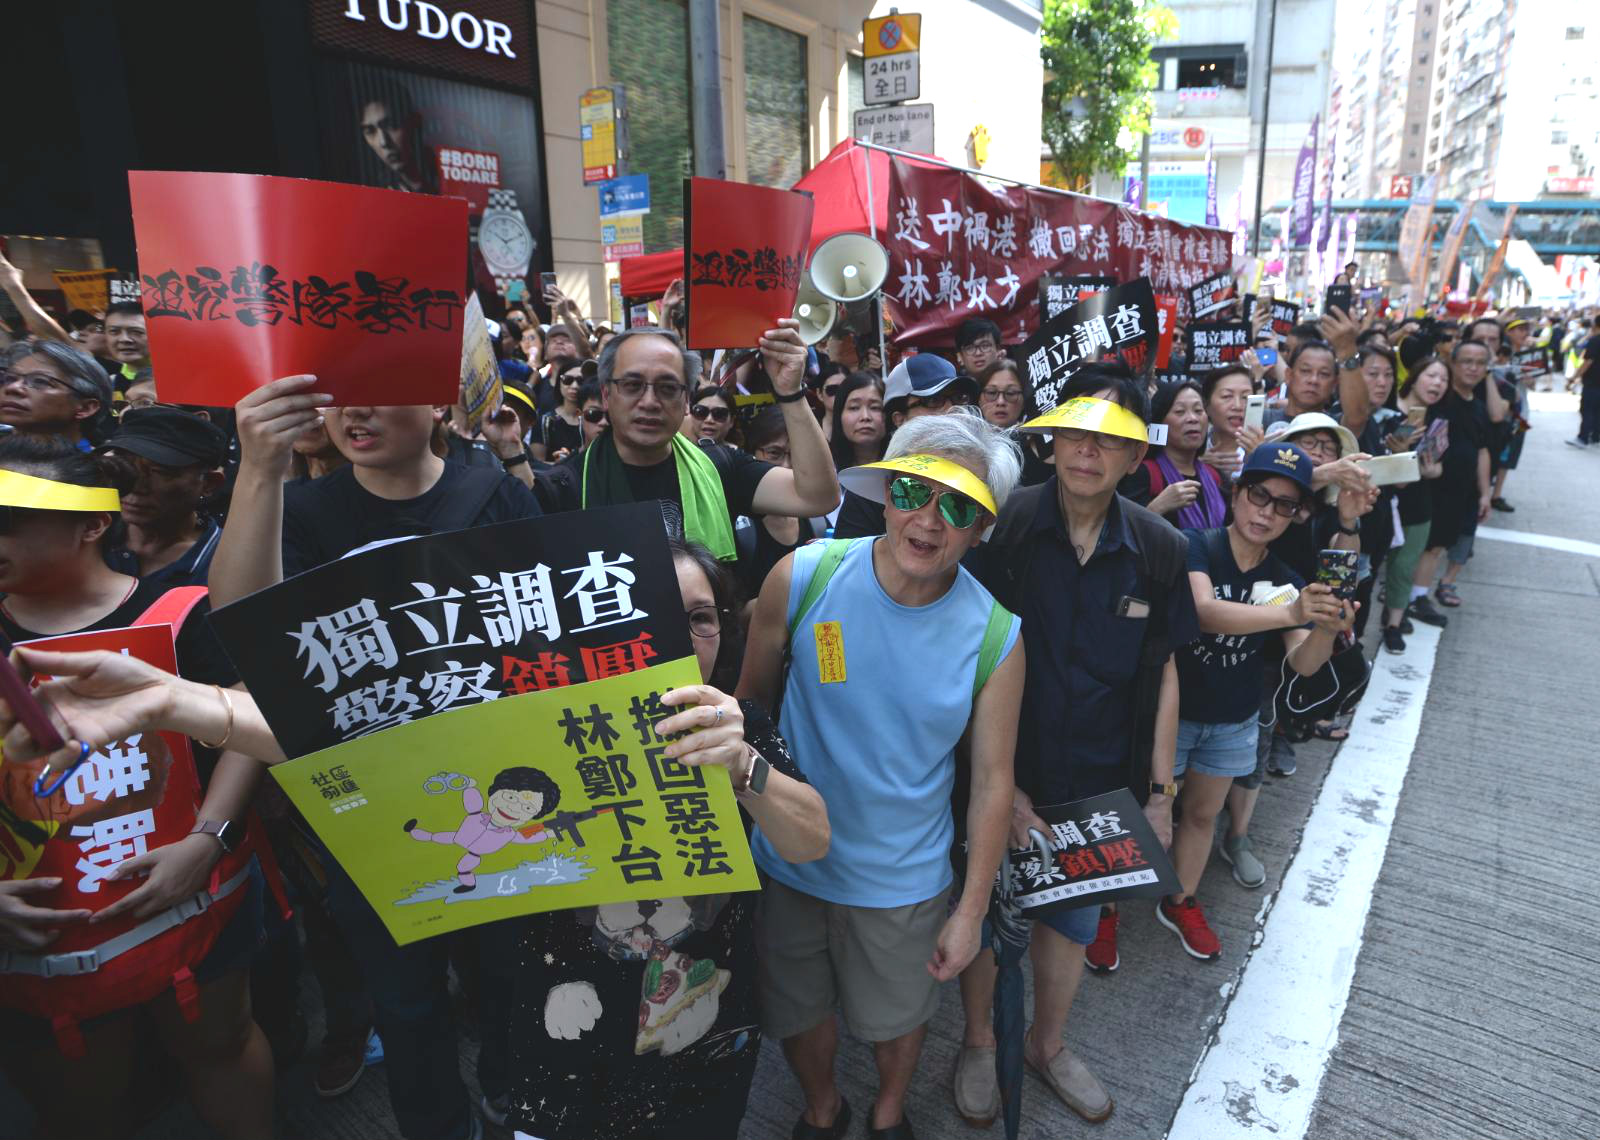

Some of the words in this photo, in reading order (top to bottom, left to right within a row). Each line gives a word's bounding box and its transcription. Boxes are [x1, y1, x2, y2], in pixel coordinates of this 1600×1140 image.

[345, 0, 516, 58] TUDOR
[870, 61, 887, 75] 24
[891, 59, 911, 72] hrs
[875, 76, 906, 97] 全日
[858, 116, 874, 126] End
[878, 114, 886, 123] of
[888, 112, 904, 122] bus
[907, 110, 930, 120] lane
[440, 149, 498, 171] #BORN
[441, 166, 499, 185] TODARE
[895, 196, 1018, 258] 送中禍港
[897, 258, 1021, 312] 林鄭奴才
[1027, 303, 1147, 388] 獨立調查
[1193, 329, 1247, 347] 獨立調查
[1213, 583, 1232, 600] EW
[286, 551, 649, 693] 獨立調查
[311, 765, 352, 787] 社區
[320, 779, 361, 800] 前進
[557, 703, 664, 884] 林鄭下台
[1018, 810, 1132, 854] 調查
